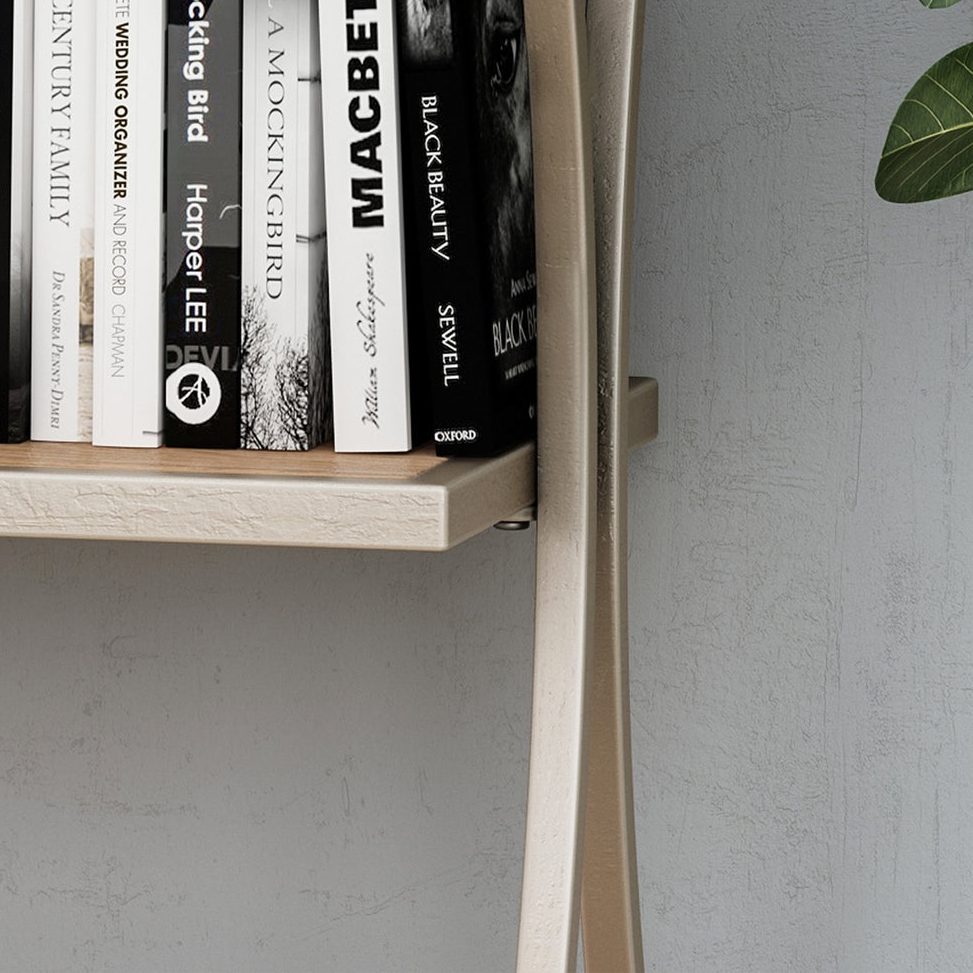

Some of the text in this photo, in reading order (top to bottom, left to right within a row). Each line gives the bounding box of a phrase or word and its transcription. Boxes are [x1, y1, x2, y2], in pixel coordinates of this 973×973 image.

[114, 22, 130, 100] WEDDING
[267, 17, 284, 37] A
[112, 104, 128, 199] ORGANIZER
[187, 89, 209, 142] Bird
[49, 126, 72, 227] FAMILY
[265, 49, 285, 300] MOCKINGBIRD
[421, 94, 451, 260] BLACK BEAUTY
[112, 204, 127, 236] AND
[182, 184, 208, 333] Harper LEE
[111, 240, 127, 296] RECORD
[111, 304, 125, 378] CHAPMAN
[357, 252, 386, 429] William Shakespeare
[438, 304, 459, 386] SEWELL
[492, 311, 526, 357] BLACK
[434, 429, 477, 442] OXFORD
